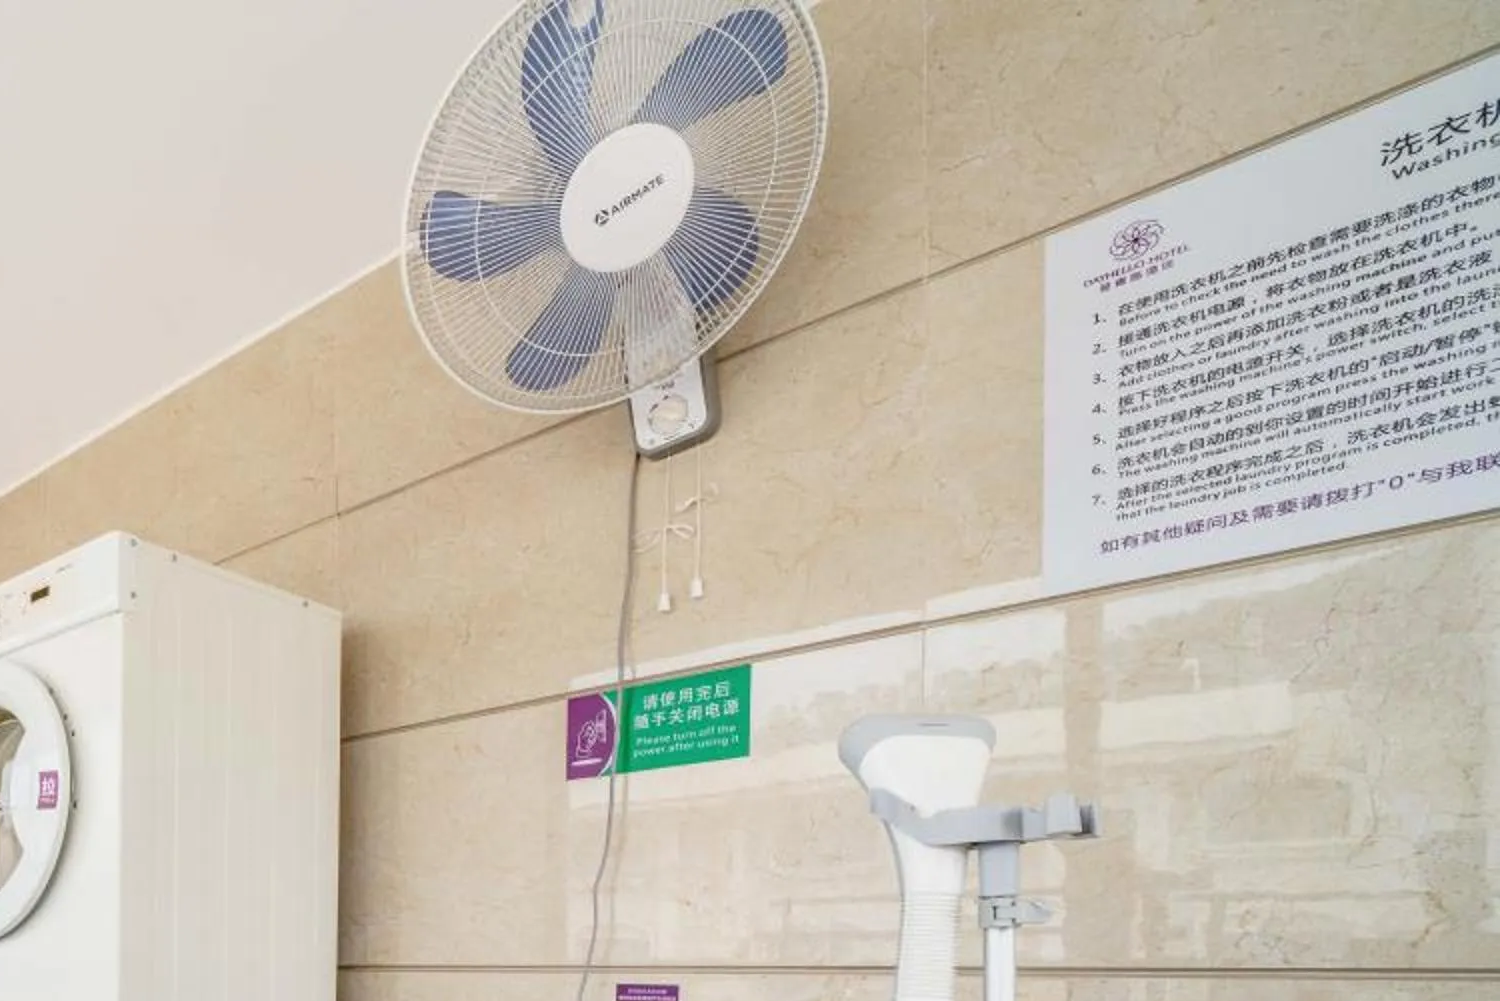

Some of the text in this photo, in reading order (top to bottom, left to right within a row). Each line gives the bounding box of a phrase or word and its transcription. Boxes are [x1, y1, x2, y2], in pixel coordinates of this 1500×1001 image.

[610, 173, 664, 216] AIRMATE
[1169, 328, 1190, 344] the
[1241, 307, 1256, 321] of
[1259, 298, 1282, 315] the
[1288, 276, 1350, 306] washing
[1356, 251, 1426, 284] machine
[1431, 239, 1465, 260] and
[1181, 285, 1220, 307] check
[1224, 276, 1246, 293] the
[1250, 262, 1286, 284] need
[1291, 255, 1306, 270] to
[1311, 240, 1350, 263] wash
[1355, 230, 1380, 248] the
[1385, 206, 1448, 238] clothes
[1155, 393, 1175, 408] the
[1179, 376, 1235, 401] washing
[1315, 338, 1363, 362] power
[1433, 303, 1485, 328] select
[1197, 353, 1211, 366] or
[1275, 323, 1310, 343] after
[1314, 301, 1379, 331] washing
[1385, 289, 1418, 309] into
[1423, 279, 1451, 298] the
[1456, 264, 1500, 287] laun
[1144, 452, 1197, 474] washing
[1201, 436, 1260, 460] machine
[1265, 429, 1288, 444] will
[1293, 400, 1400, 437] automatically
[1406, 389, 1445, 408] start
[1451, 376, 1495, 397] work
[1225, 404, 1262, 423] good
[1266, 385, 1330, 412] program
[1335, 373, 1376, 394] press
[1382, 364, 1408, 381] the
[1414, 343, 1485, 373] washing
[1145, 502, 1166, 516] the
[1169, 490, 1219, 511] laundry
[1222, 483, 1246, 498] job
[1250, 480, 1260, 492] is
[1151, 489, 1172, 503] the
[1175, 475, 1231, 497] selected
[1235, 461, 1290, 483] laundry
[1295, 443, 1362, 469] program
[1367, 440, 1378, 452] is
